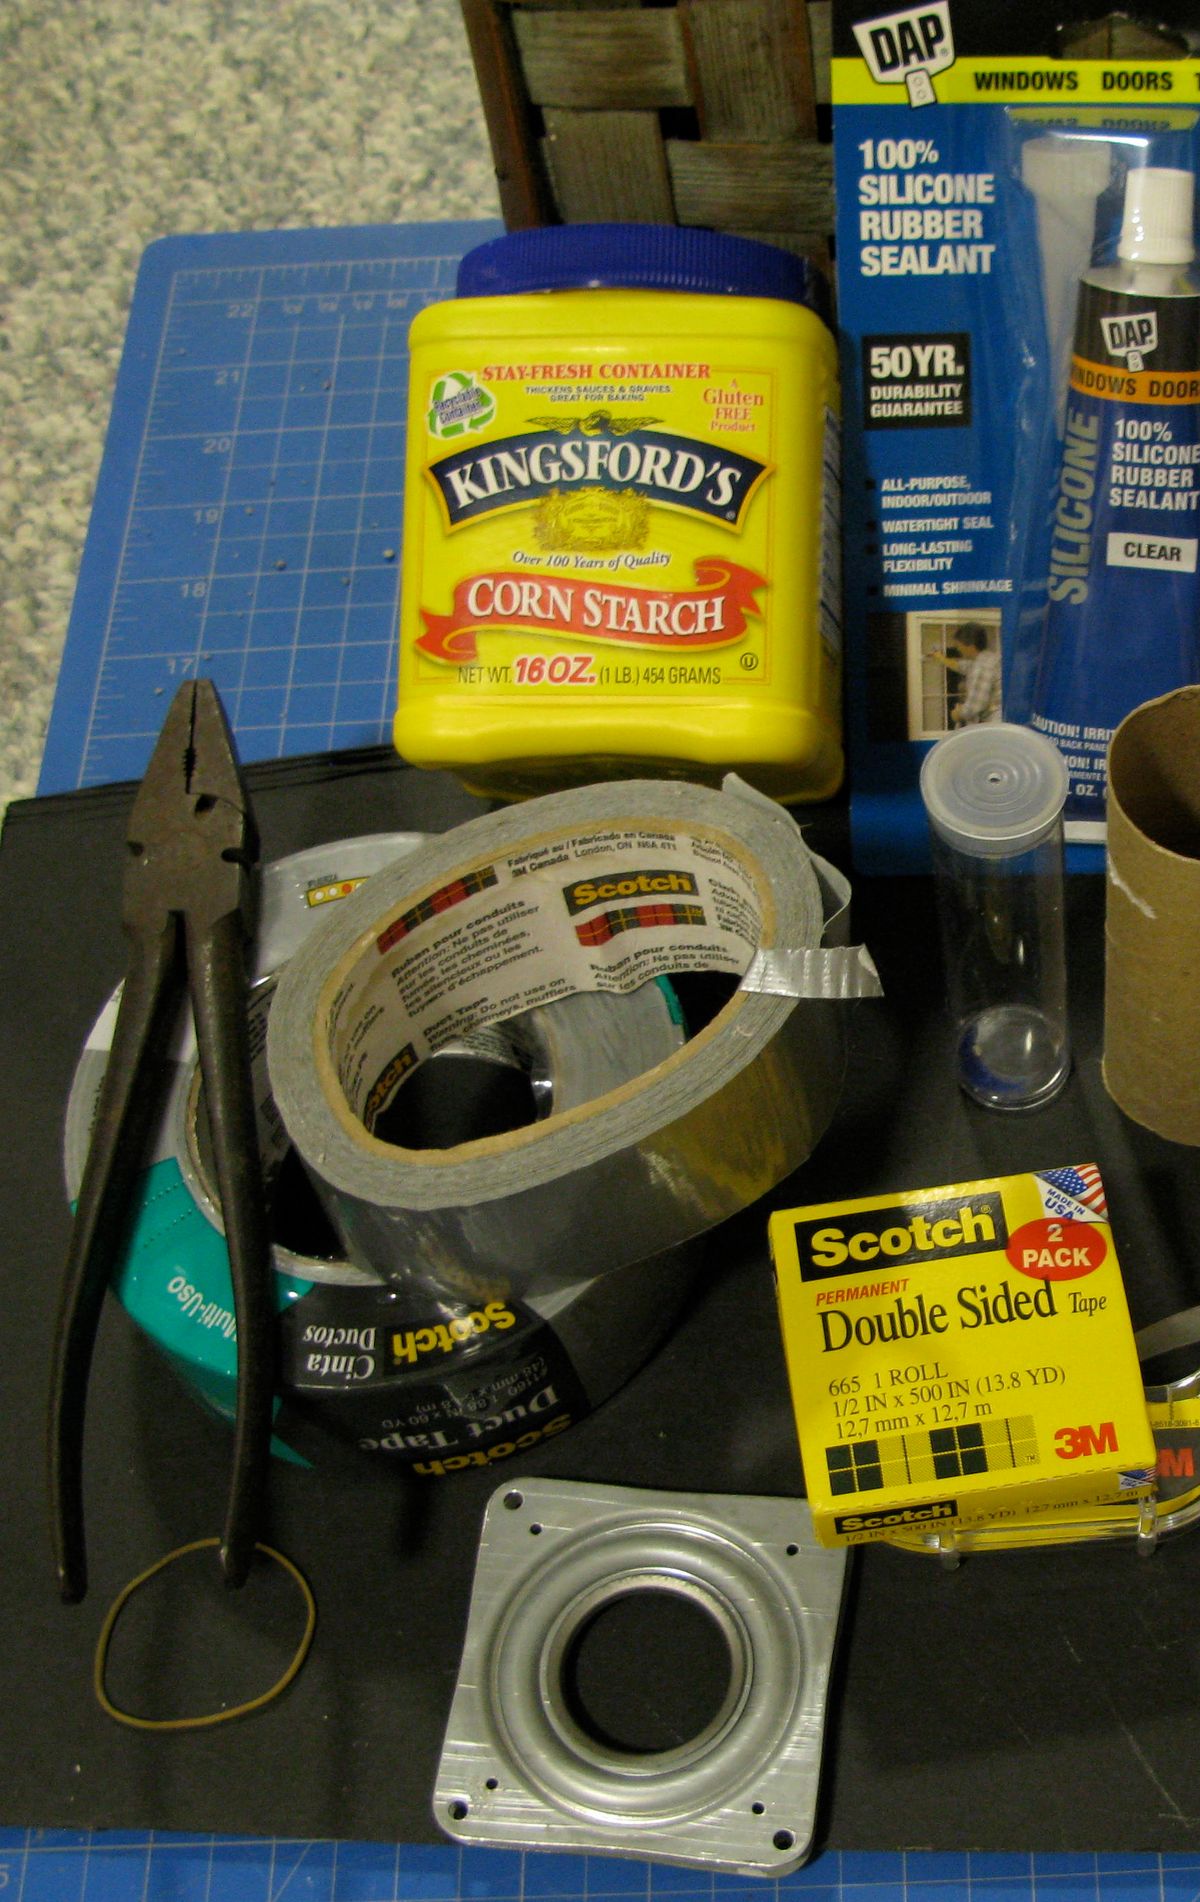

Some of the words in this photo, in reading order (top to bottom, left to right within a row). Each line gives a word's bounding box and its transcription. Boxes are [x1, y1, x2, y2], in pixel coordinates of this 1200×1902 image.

[868, 13, 946, 74] DAP
[974, 71, 1079, 91] WINDOWS
[1102, 72, 1173, 91] DOORS
[859, 139, 939, 169] 100%
[859, 173, 995, 205] SILICONE
[860, 210, 983, 240] RUBBER
[860, 244, 996, 277] SEALANT
[1108, 320, 1153, 349] DAP
[482, 365, 593, 381] STAY-FRESH
[600, 364, 710, 379] CONTAINER
[703, 388, 764, 407] Gluten
[870, 383, 962, 401] DURABILITY
[715, 407, 752, 421] FREE
[870, 401, 963, 418] GUARANTEE
[711, 421, 755, 433] Product
[1115, 419, 1172, 442] 100%
[203, 437, 232, 454] 20
[1112, 442, 1200, 466] SILICONE
[444, 440, 742, 510] KINGSFORD'S
[1111, 465, 1194, 489] RUBBER
[1047, 406, 1100, 605] SILICONE
[1109, 488, 1200, 511] SEALANT
[193, 509, 219, 525] 19
[882, 517, 959, 534] WATERTIGHT
[963, 515, 994, 530] SEAL
[512, 551, 542, 566] Over
[546, 554, 570, 568] 100
[573, 555, 605, 569] Years
[607, 554, 622, 572] of
[624, 551, 671, 570] Quality
[1123, 542, 1181, 563] CLEAR
[883, 557, 954, 574] FLEXIBILITY
[180, 581, 207, 598] 18
[883, 581, 939, 597] MINIMAL
[942, 579, 1013, 595] SHRINKAGE
[467, 579, 574, 621] CORN
[583, 588, 726, 637] STARCH
[167, 658, 194, 675] 17
[458, 668, 485, 684] NET
[488, 667, 512, 684] WT.
[515, 657, 546, 684] 16
[548, 656, 596, 684] OZ.
[642, 667, 665, 684] 454
[668, 667, 721, 684] GRAMS
[572, 874, 692, 905] Scotch
[433, 928, 462, 950] pour
[466, 901, 525, 930] conduits
[634, 946, 665, 961] pour
[523, 984, 546, 997] use
[550, 977, 565, 988] on
[1044, 1197, 1075, 1220] USA
[1047, 1188, 1072, 1210] MADE
[810, 1206, 996, 1268] Scotch
[1047, 1224, 1063, 1242] 2
[1022, 1248, 1092, 1268] PACK
[816, 1279, 910, 1306] PERMANENT
[818, 1294, 949, 1353] Double
[957, 1276, 1058, 1330] Sided
[1069, 1291, 1107, 1316] Tape
[303, 1324, 376, 1349] Ductos
[392, 1301, 516, 1365] Scotch
[307, 1354, 375, 1379] Cinta
[828, 1375, 861, 1397] 665
[875, 1372, 883, 1390] 1
[889, 1362, 949, 1386] ROLL
[833, 1397, 862, 1418] 1/2
[865, 1393, 888, 1412] IN
[909, 1383, 944, 1405] 500
[948, 1379, 970, 1399] IN
[976, 1370, 1023, 1398] (13.8
[1030, 1365, 1066, 1391] YD)
[466, 1383, 560, 1438] Duct
[836, 1419, 870, 1442] 12,7
[875, 1417, 910, 1435] mm
[933, 1403, 971, 1424] 12,7
[975, 1403, 993, 1417] m
[358, 1429, 459, 1452] Tape
[413, 1412, 572, 1477] Scotch
[1054, 1422, 1119, 1460] 3M
[840, 1503, 953, 1531] Scotch
